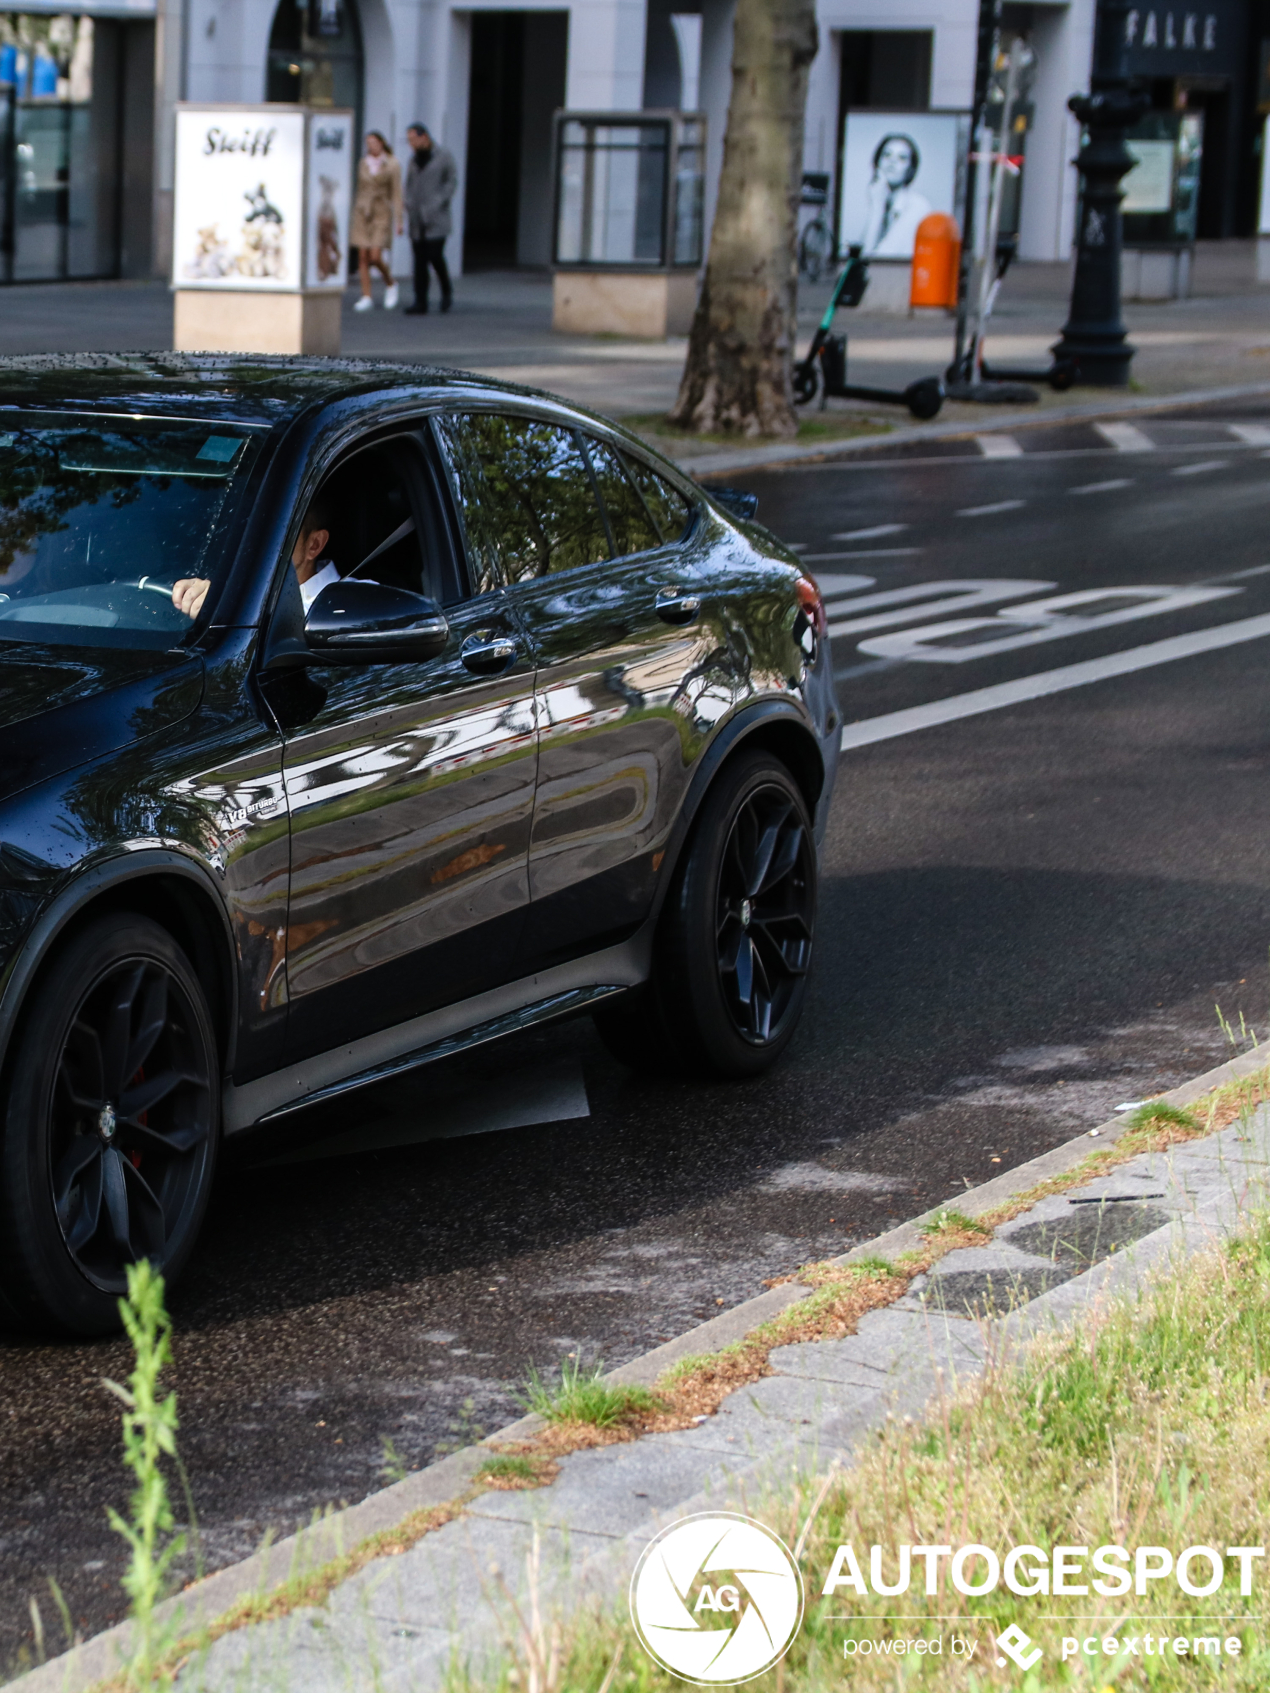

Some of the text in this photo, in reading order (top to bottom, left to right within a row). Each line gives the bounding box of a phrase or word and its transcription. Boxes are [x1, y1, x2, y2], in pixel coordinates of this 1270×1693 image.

[1124, 9, 1218, 51] FALKE
[203, 126, 278, 157] Steiff
[228, 808, 247, 823] V8
[247, 797, 278, 813] BITURBO
